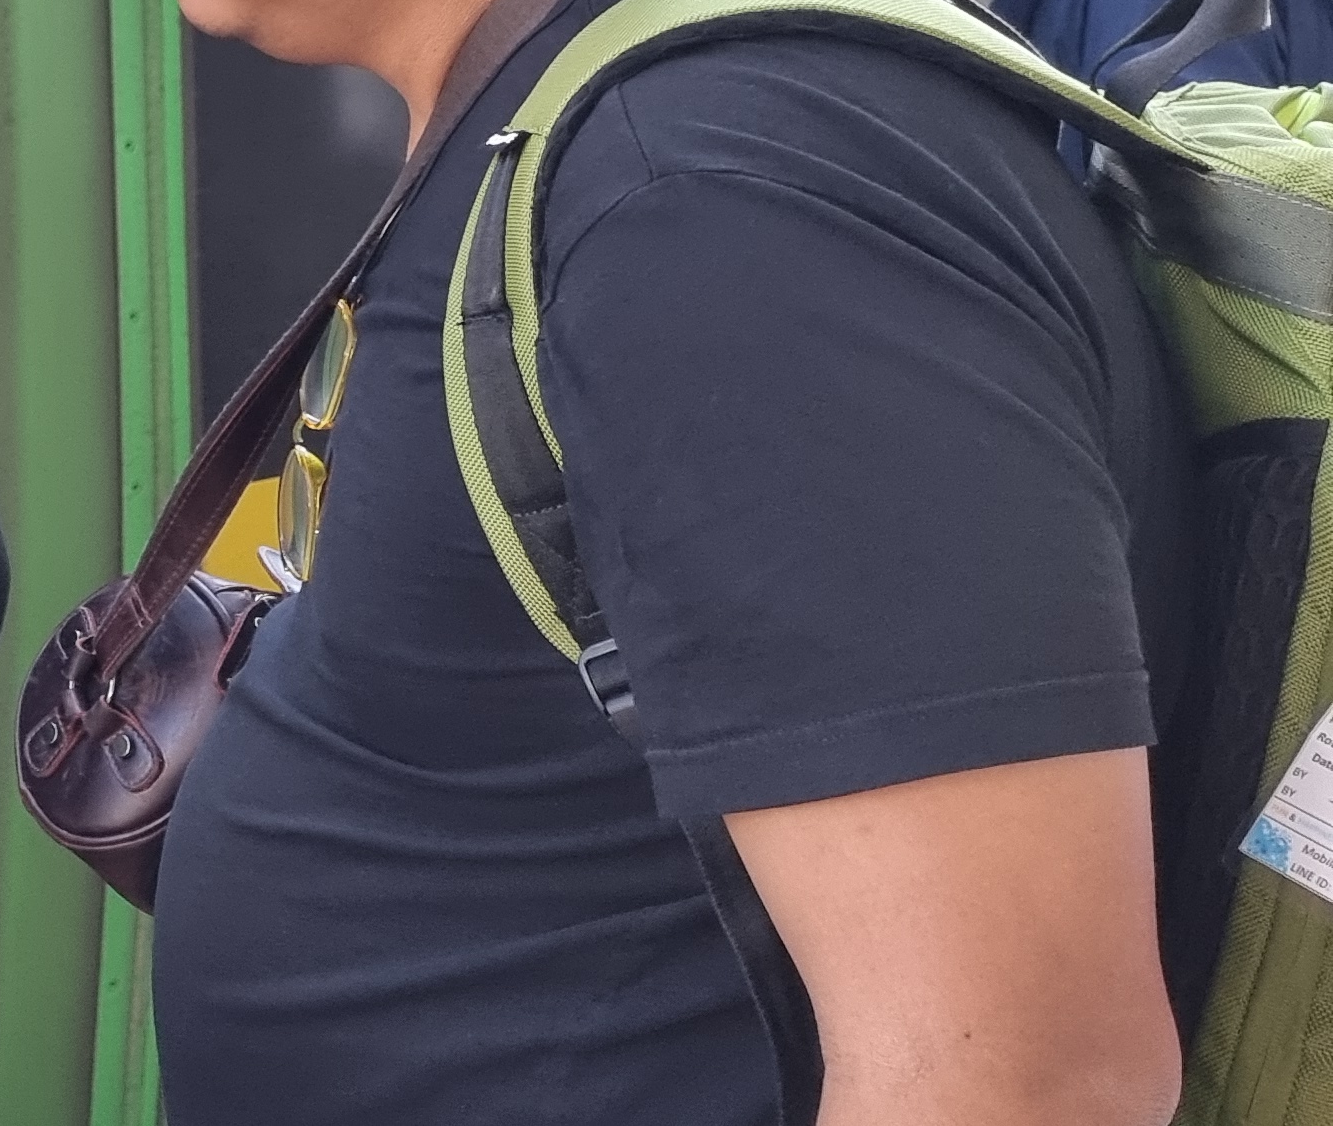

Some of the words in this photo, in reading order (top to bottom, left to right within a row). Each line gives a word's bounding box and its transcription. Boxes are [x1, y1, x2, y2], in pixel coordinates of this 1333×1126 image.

[1317, 732, 1333, 749] Ro
[1302, 844, 1333, 869] Mobil
[1290, 862, 1314, 881] LINE
